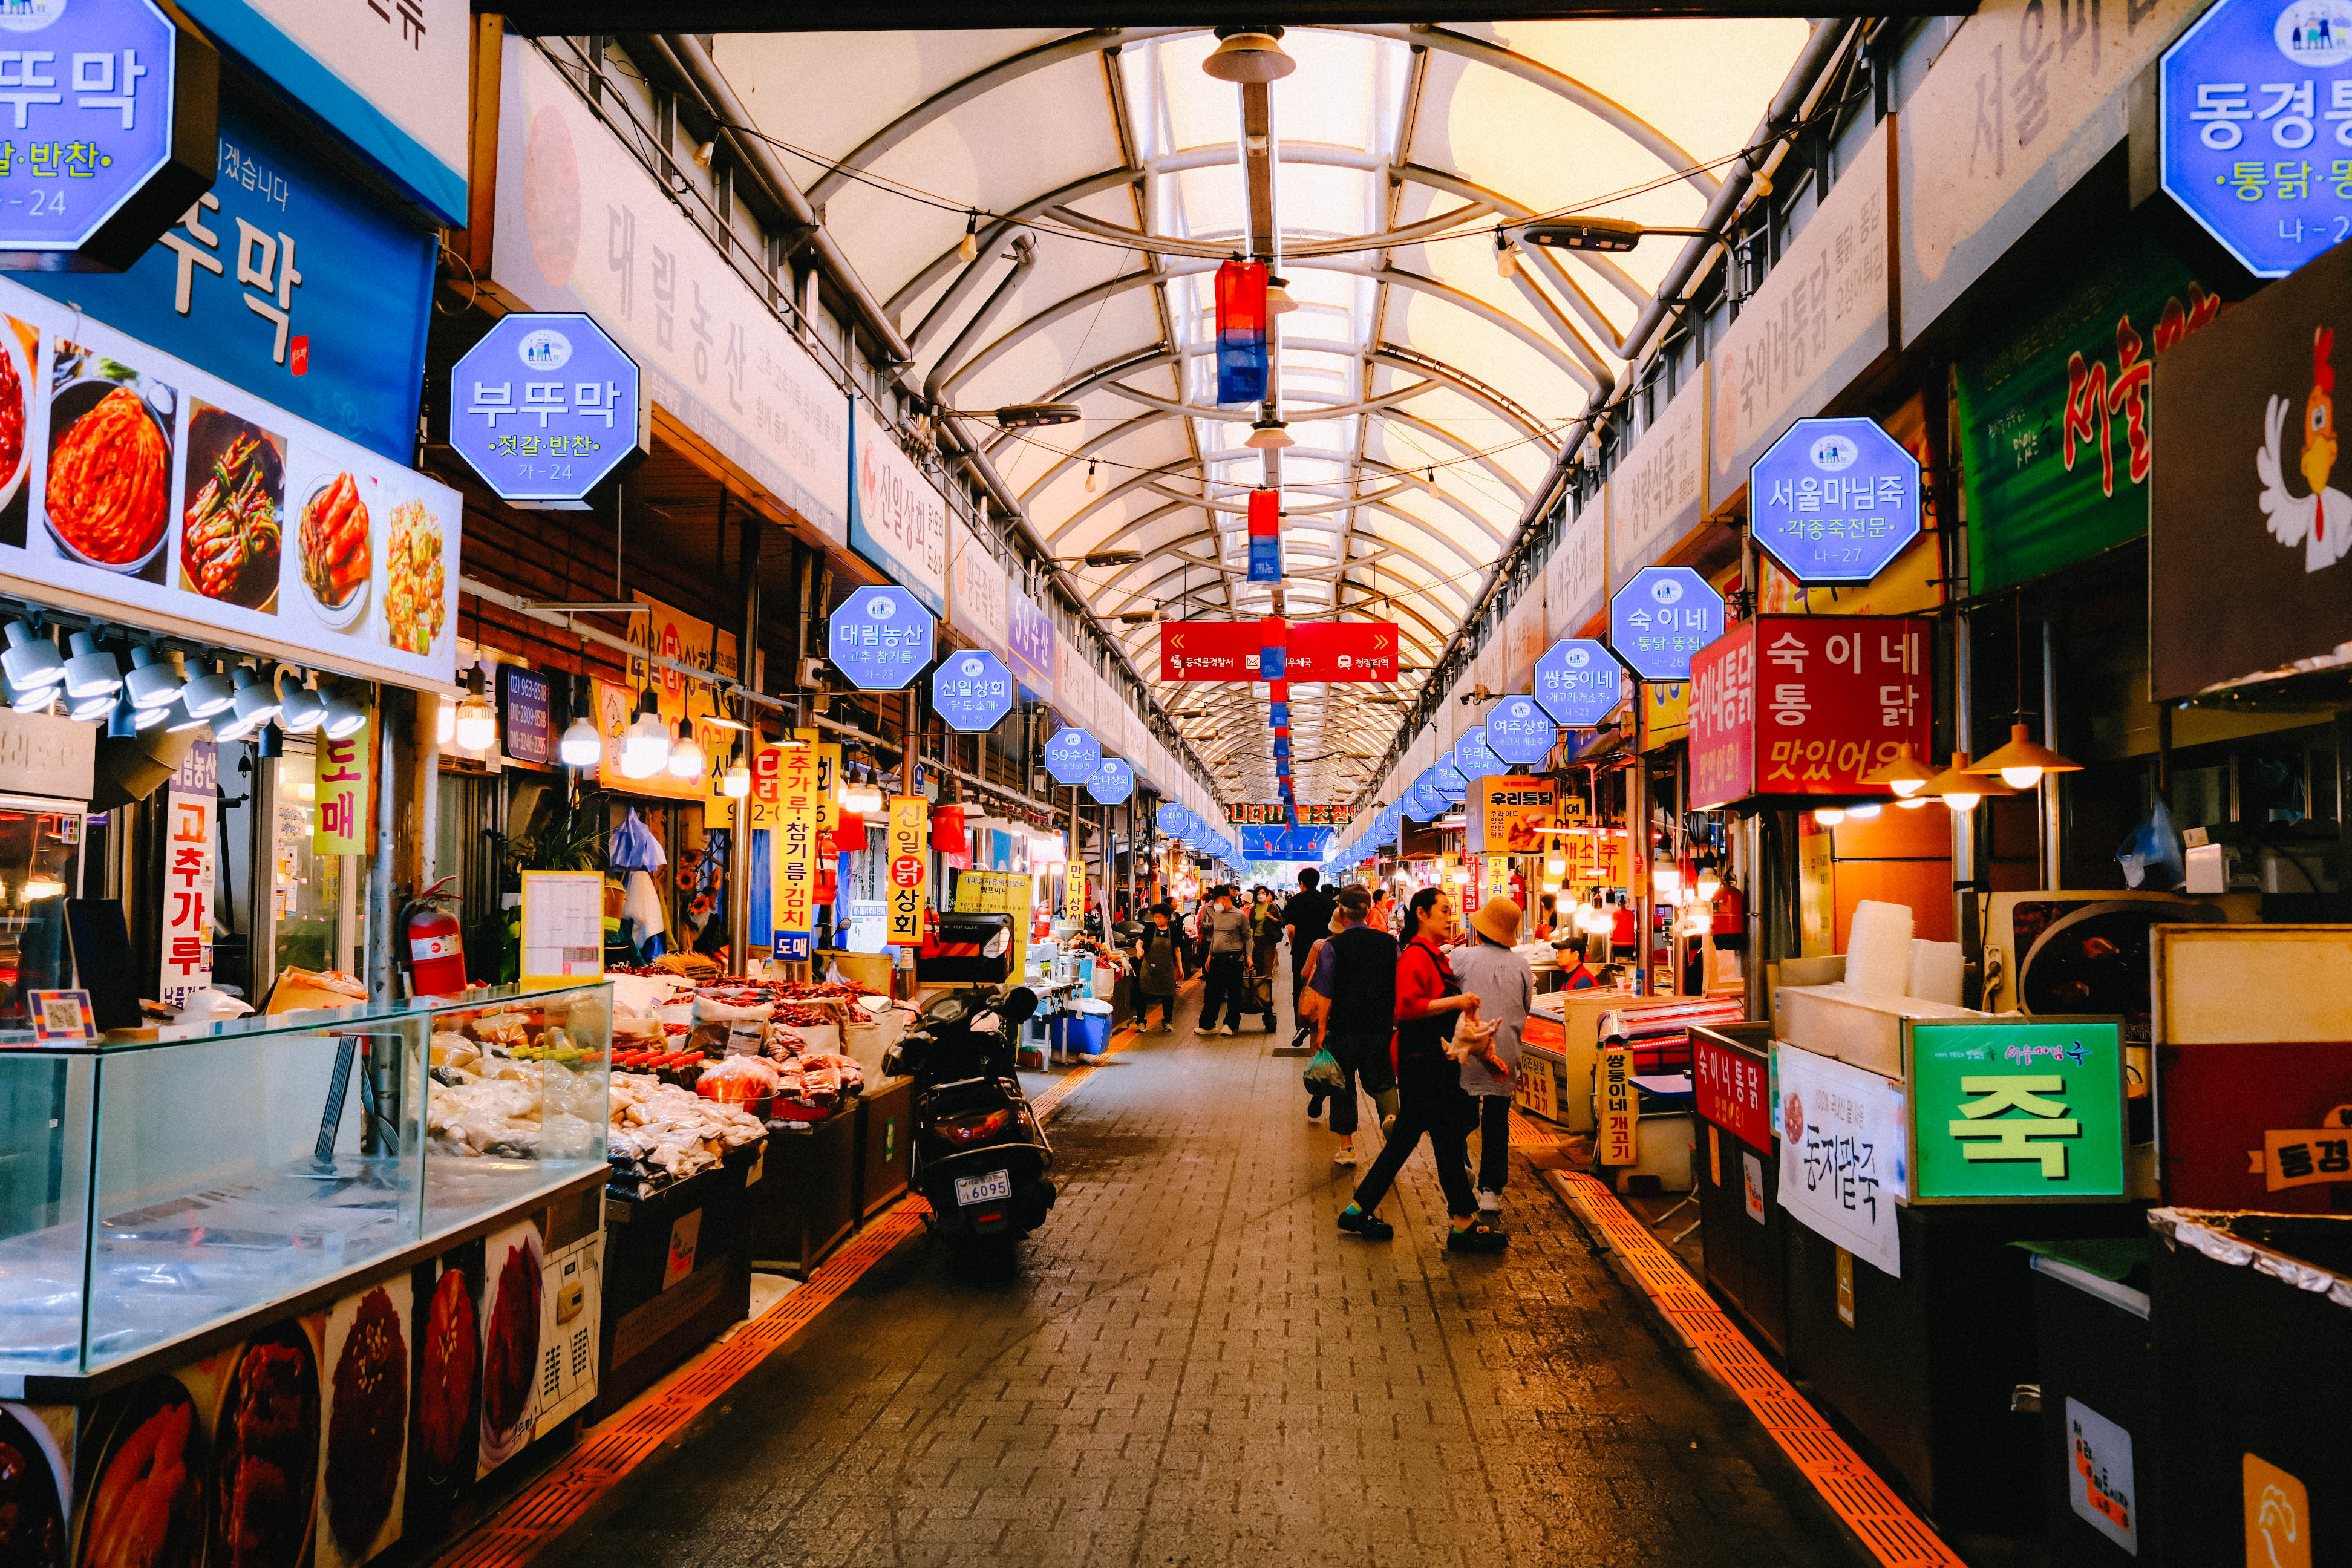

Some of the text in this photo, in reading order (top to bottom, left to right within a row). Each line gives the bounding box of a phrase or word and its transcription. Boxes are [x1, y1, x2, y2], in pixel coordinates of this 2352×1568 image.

[218, 137, 290, 212] 겠습니다
[0, 189, 66, 216] -24
[607, 202, 747, 417] 대림농산
[1740, 249, 1831, 427] 숙이네통닭
[468, 381, 622, 429] 부뚜막
[1768, 475, 1906, 514] 서울마님죽
[880, 465, 925, 564] 신일상회
[1814, 547, 1862, 563] 나-27
[967, 555, 995, 626] 황금족발
[1627, 607, 1708, 632] 숙이네
[840, 624, 924, 647] 대림농산
[1186, 657, 1233, 668] 동대문경찰서
[1284, 658, 1312, 668] 우체국
[1355, 657, 1389, 668] 청량리역
[1650, 656, 1684, 668] 나-26
[1766, 631, 1919, 675] 숙이네
[521, 678, 547, 702] 963-8518
[941, 679, 1005, 699] 신일상회
[1543, 670, 1613, 690] 쌍둥이네
[1688, 640, 1753, 744] 숙이네통닭
[510, 702, 547, 728] 010-2809-8518
[1494, 719, 1550, 736] 여주상회
[509, 730, 546, 755] 010-3246-2295
[1051, 749, 1097, 762] 59수산
[1462, 746, 1495, 760] 우리통
[1091, 774, 1129, 786] 만나상회
[1699, 742, 1740, 795] 맛있어요!
[319, 739, 362, 840] 도매
[1490, 792, 1554, 806] 우리통닭
[892, 804, 924, 937] 신일닭상회
[1491, 858, 1504, 898] 고추·참
[169, 803, 208, 976] 고추가루
[776, 938, 808, 958] 도매
[1521, 1055, 1546, 1077] 여주상회
[2004, 1039, 2092, 1068] 서울마님죽
[1606, 1054, 1630, 1158] 쌍둥이네 개고기
[1949, 1074, 2082, 1180] 죽
[1803, 1123, 1880, 1227] 동지팥죽
[972, 1181, 1006, 1198] 6095
